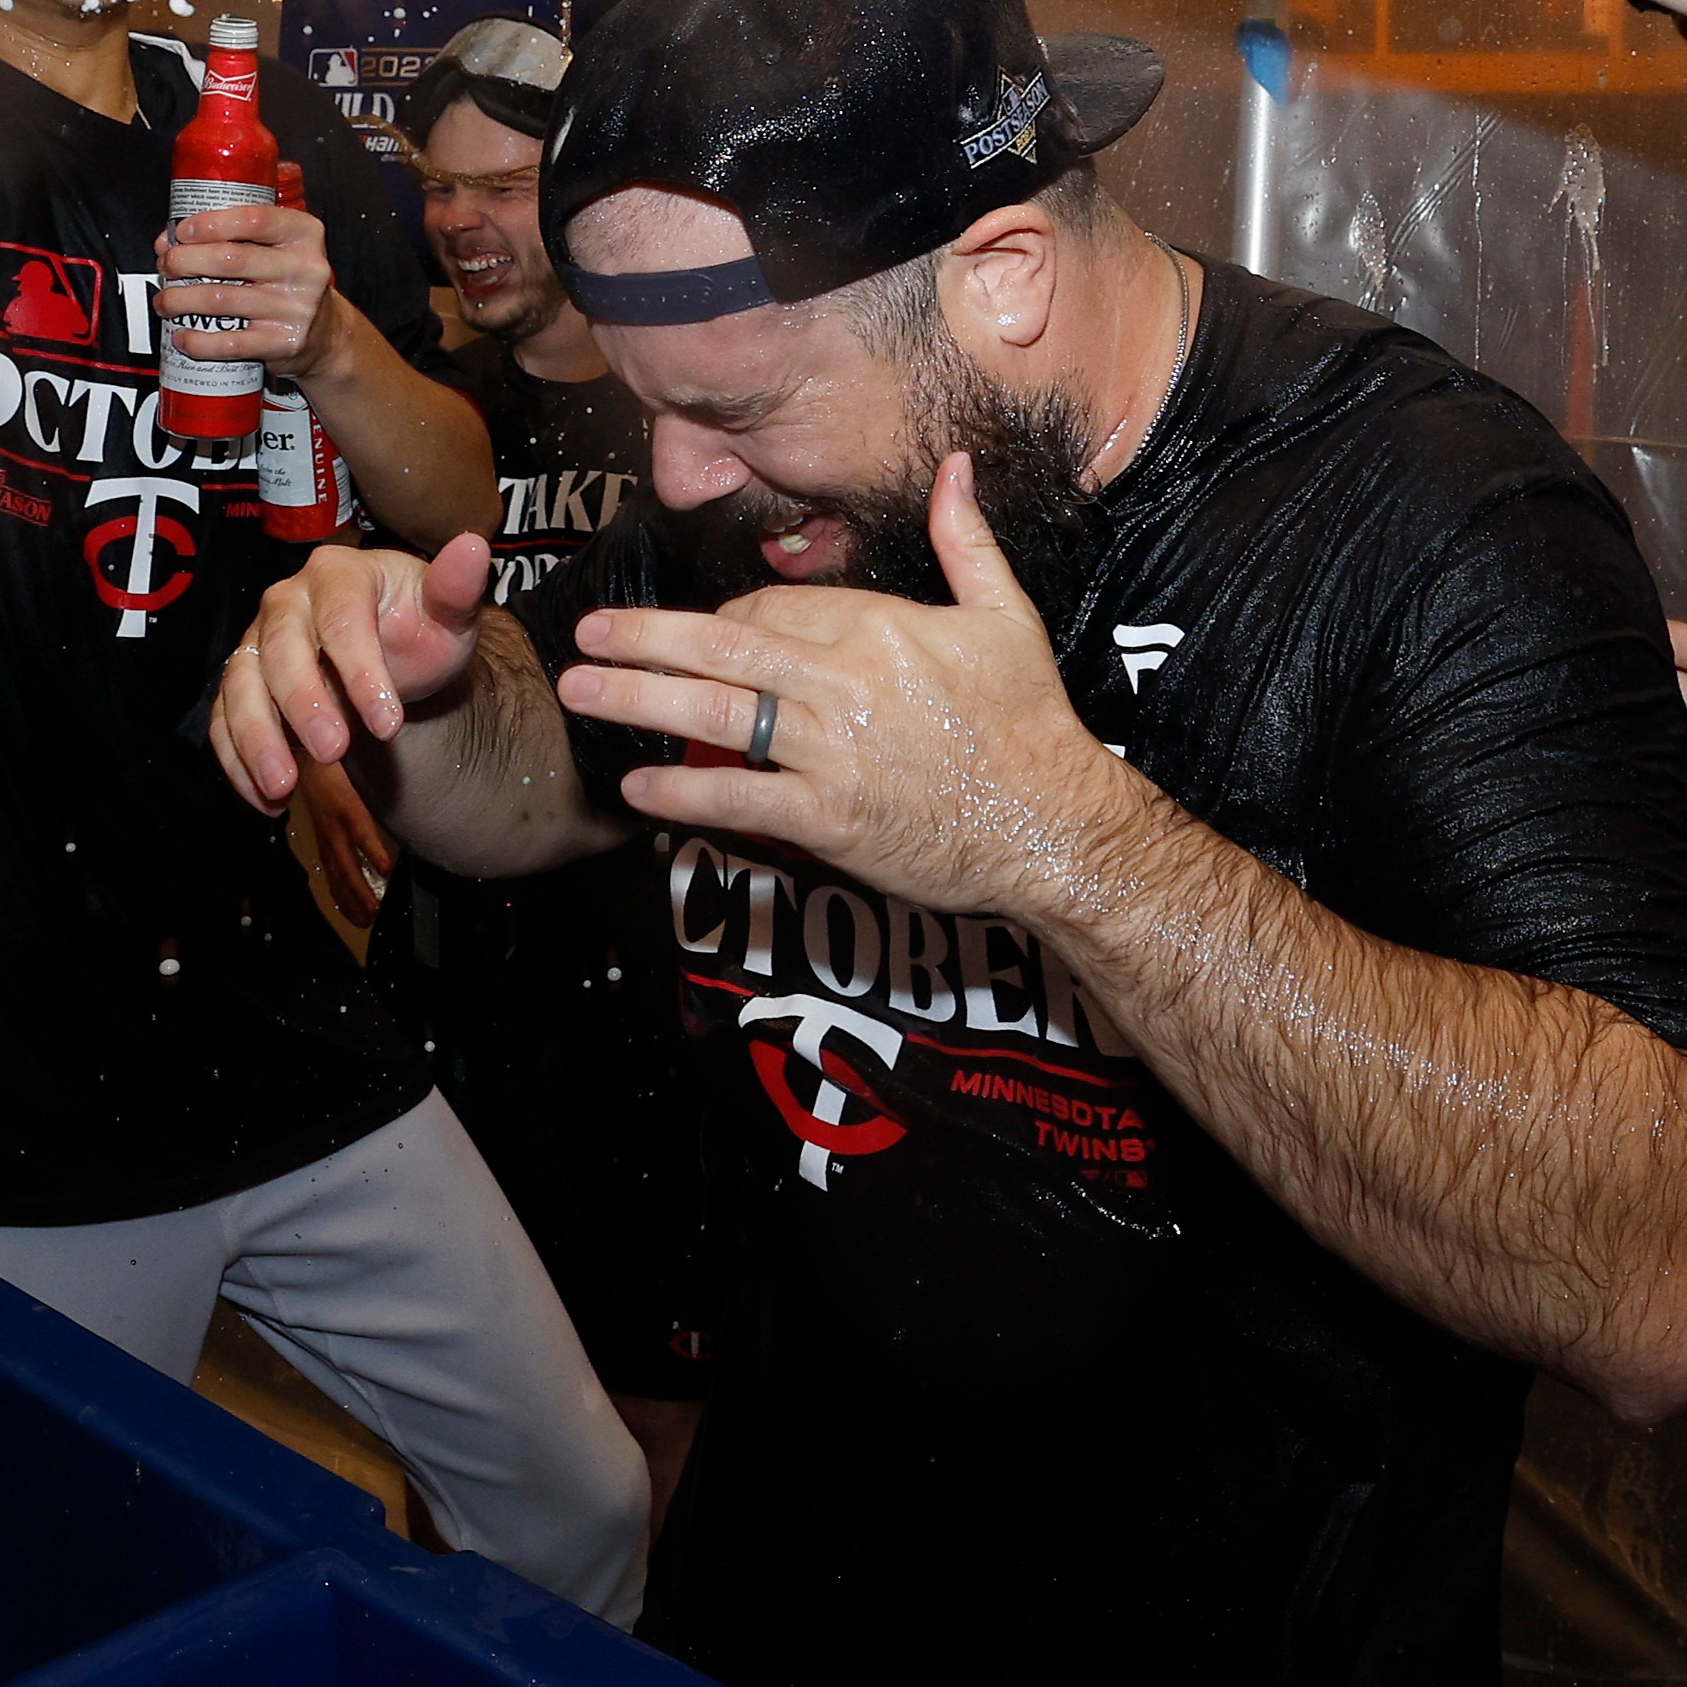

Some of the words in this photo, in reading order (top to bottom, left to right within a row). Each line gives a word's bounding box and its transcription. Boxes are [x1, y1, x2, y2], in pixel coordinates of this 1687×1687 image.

[963, 78, 1050, 164] POSTSEASON
[654, 833, 1140, 1058] CTOBER
[950, 1070, 1145, 1130] MINNESOTA
[1034, 1119, 1147, 1163] TWINS
